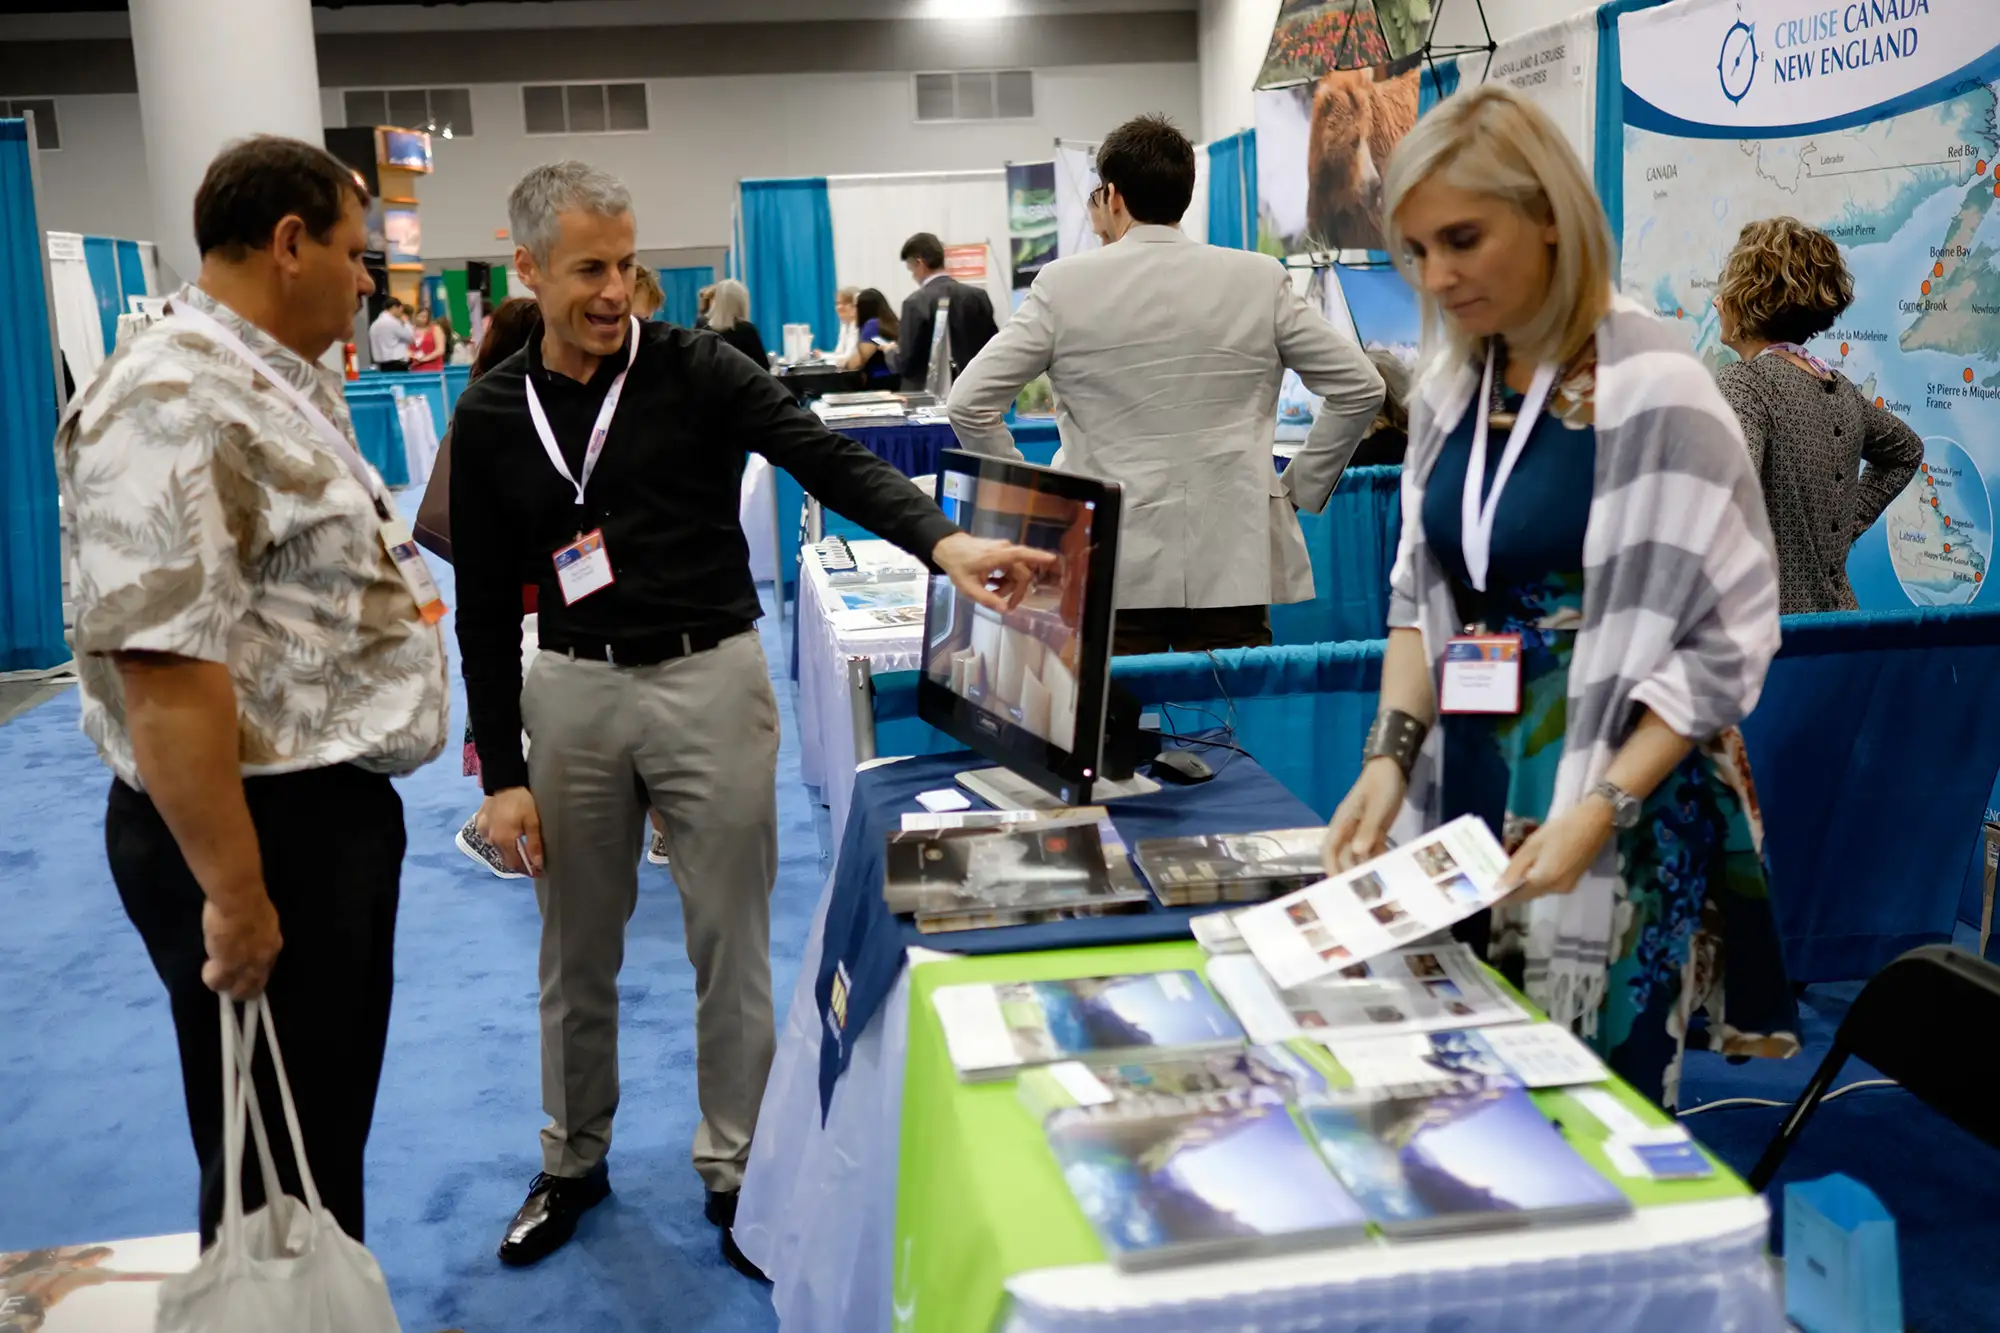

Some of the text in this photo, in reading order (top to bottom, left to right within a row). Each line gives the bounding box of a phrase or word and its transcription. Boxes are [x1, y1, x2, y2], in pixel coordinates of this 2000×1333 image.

[1775, 0, 1929, 49] CRUISE CANADA
[1774, 27, 1918, 84] NEW ENGLAND
[1948, 144, 1980, 158] Red Bay
[1820, 154, 1844, 166] Labrador
[1646, 164, 1678, 182] CANADA
[1855, 224, 1876, 236] Pierre
[1930, 246, 1972, 258] Bonne Bay
[1899, 300, 1948, 311] Corner Brook
[1837, 329, 1845, 340] de
[1846, 329, 1852, 340] la
[1853, 330, 1888, 342] Madeleine
[1927, 382, 1936, 395] St
[1937, 383, 1961, 397] Pierre
[1885, 400, 1911, 415] Sydney
[1926, 398, 1952, 410] France
[1899, 531, 1927, 544] Labrador
